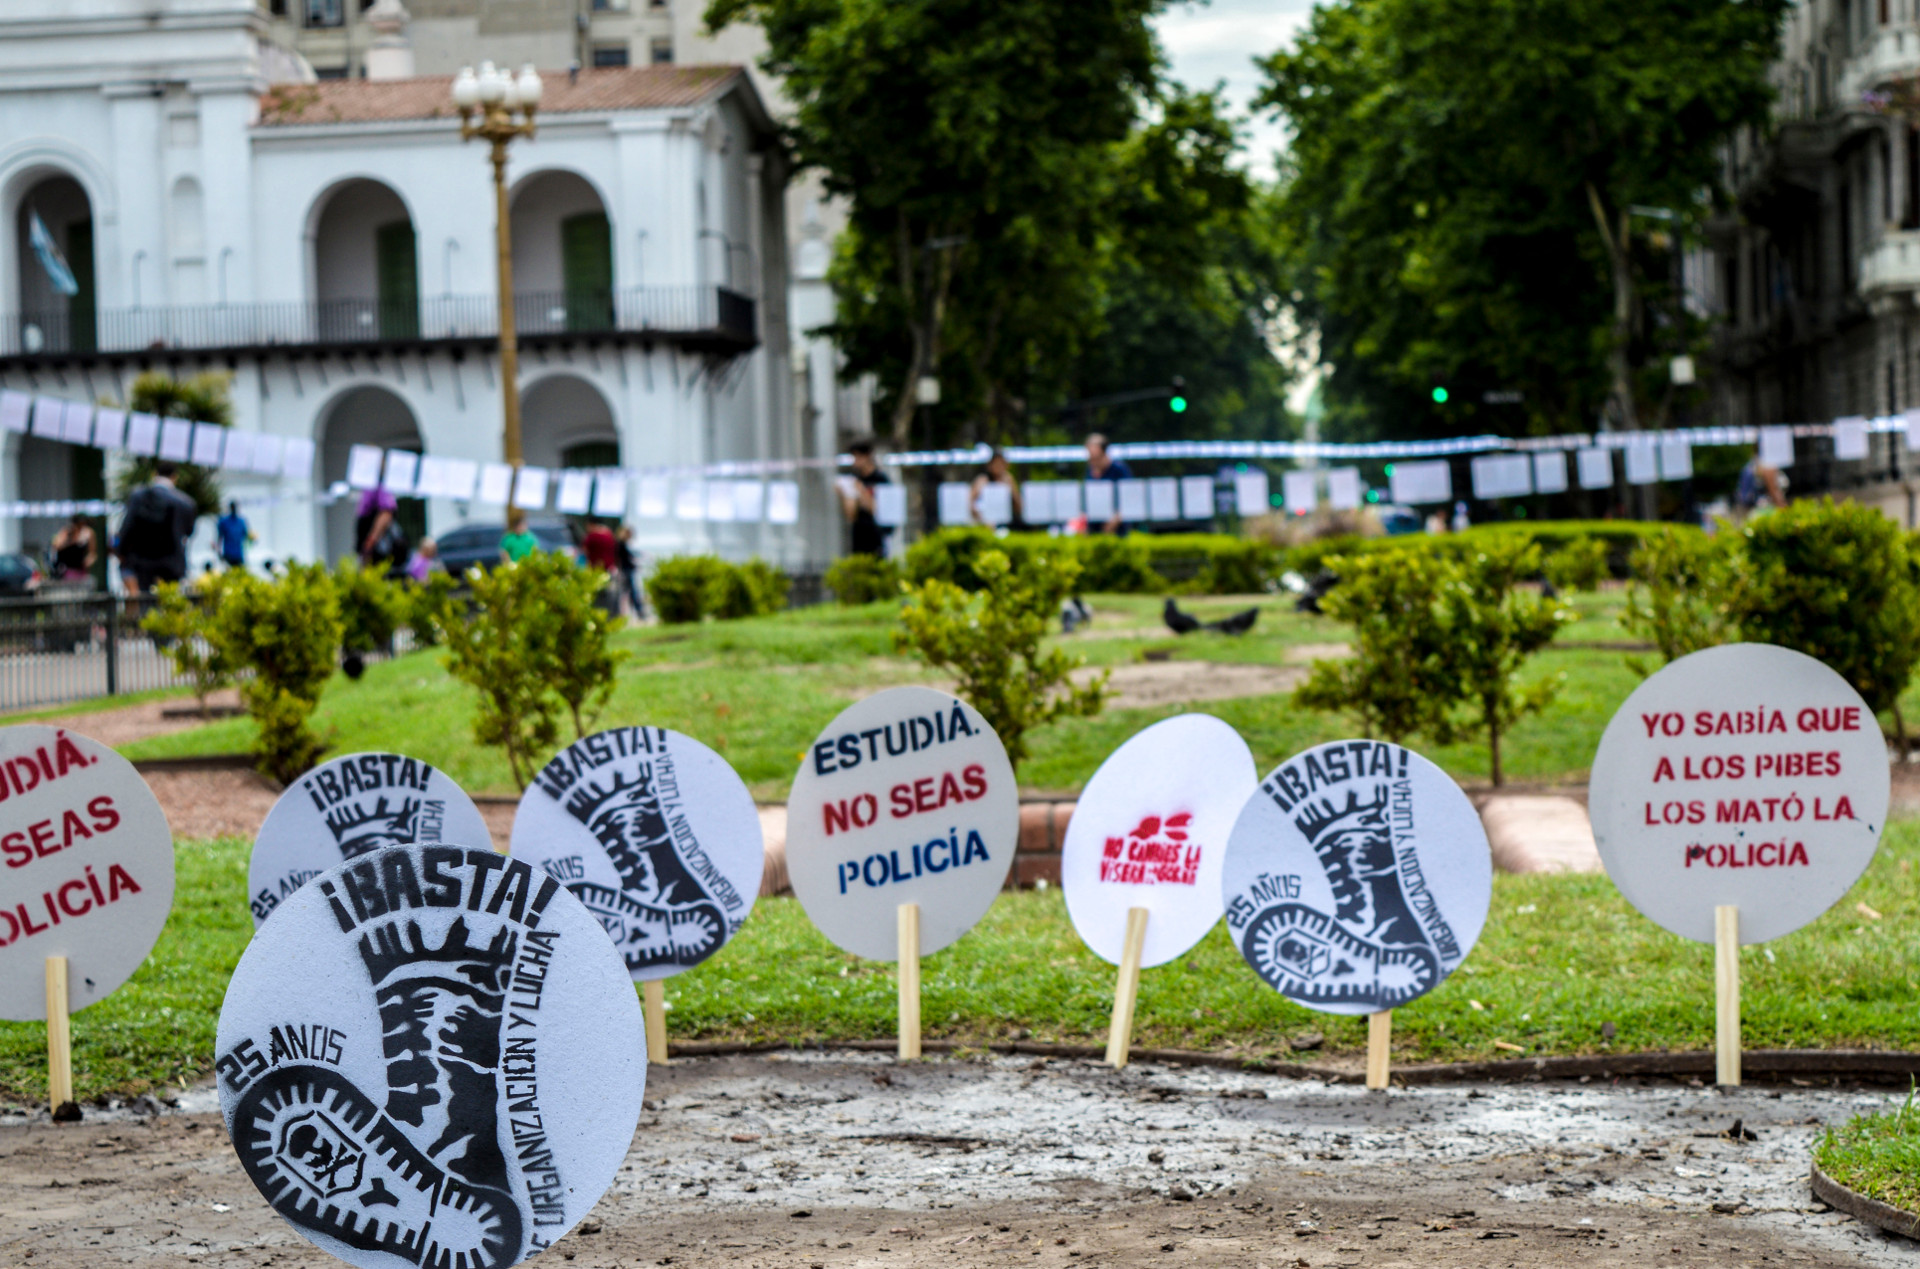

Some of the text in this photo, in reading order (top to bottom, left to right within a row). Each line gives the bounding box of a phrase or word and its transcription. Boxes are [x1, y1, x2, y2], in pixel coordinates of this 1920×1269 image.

[814, 699, 980, 776] ESTUDIÁ.
[1642, 705, 1860, 738] YO SABÍA QUE
[303, 755, 433, 813] ¡BASTA!
[534, 726, 667, 801] ¡BASTA!
[655, 753, 680, 800] LUCHA
[1262, 742, 1409, 814] ¡BASTA!
[1653, 751, 1841, 783] A LOS PIBES
[421, 800, 446, 843] UCHA
[664, 803, 683, 815] Y
[823, 764, 988, 836] NO SEAS
[1393, 779, 1414, 830] LUCHA
[1645, 792, 1855, 826] LOS MATÓ LA
[0, 795, 120, 869] SEAS
[1685, 837, 1809, 868] POLICÍA
[839, 827, 990, 895] POLICÍA
[251, 888, 279, 919] 25
[320, 848, 560, 933] ¡BASTA!
[1226, 873, 1302, 929] 25 AÑOS
[510, 931, 560, 1010] LUCHA
[507, 1012, 537, 1030] Y
[215, 1038, 269, 1092] 25
